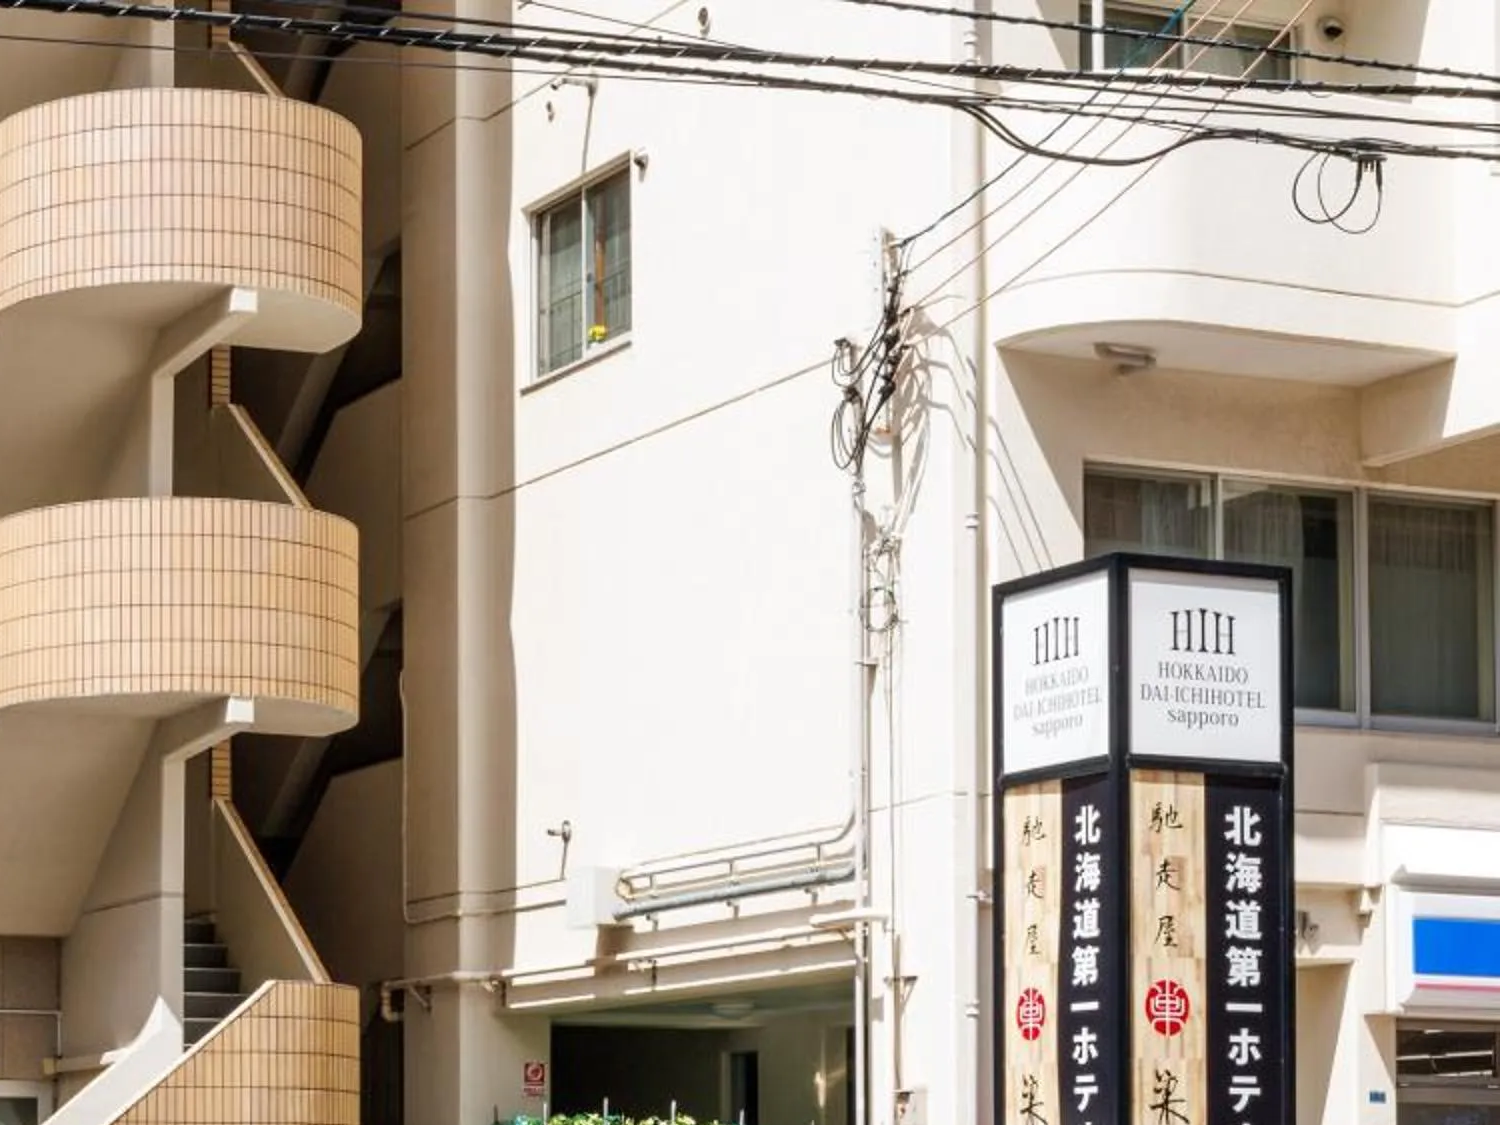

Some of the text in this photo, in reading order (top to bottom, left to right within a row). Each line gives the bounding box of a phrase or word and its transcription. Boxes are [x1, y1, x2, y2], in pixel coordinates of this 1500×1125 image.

[1024, 666, 1089, 698] HOKKAIDO
[1157, 660, 1249, 685] HOKKAIDO
[1031, 713, 1084, 741] sapporo
[1166, 706, 1239, 729] sapporo
